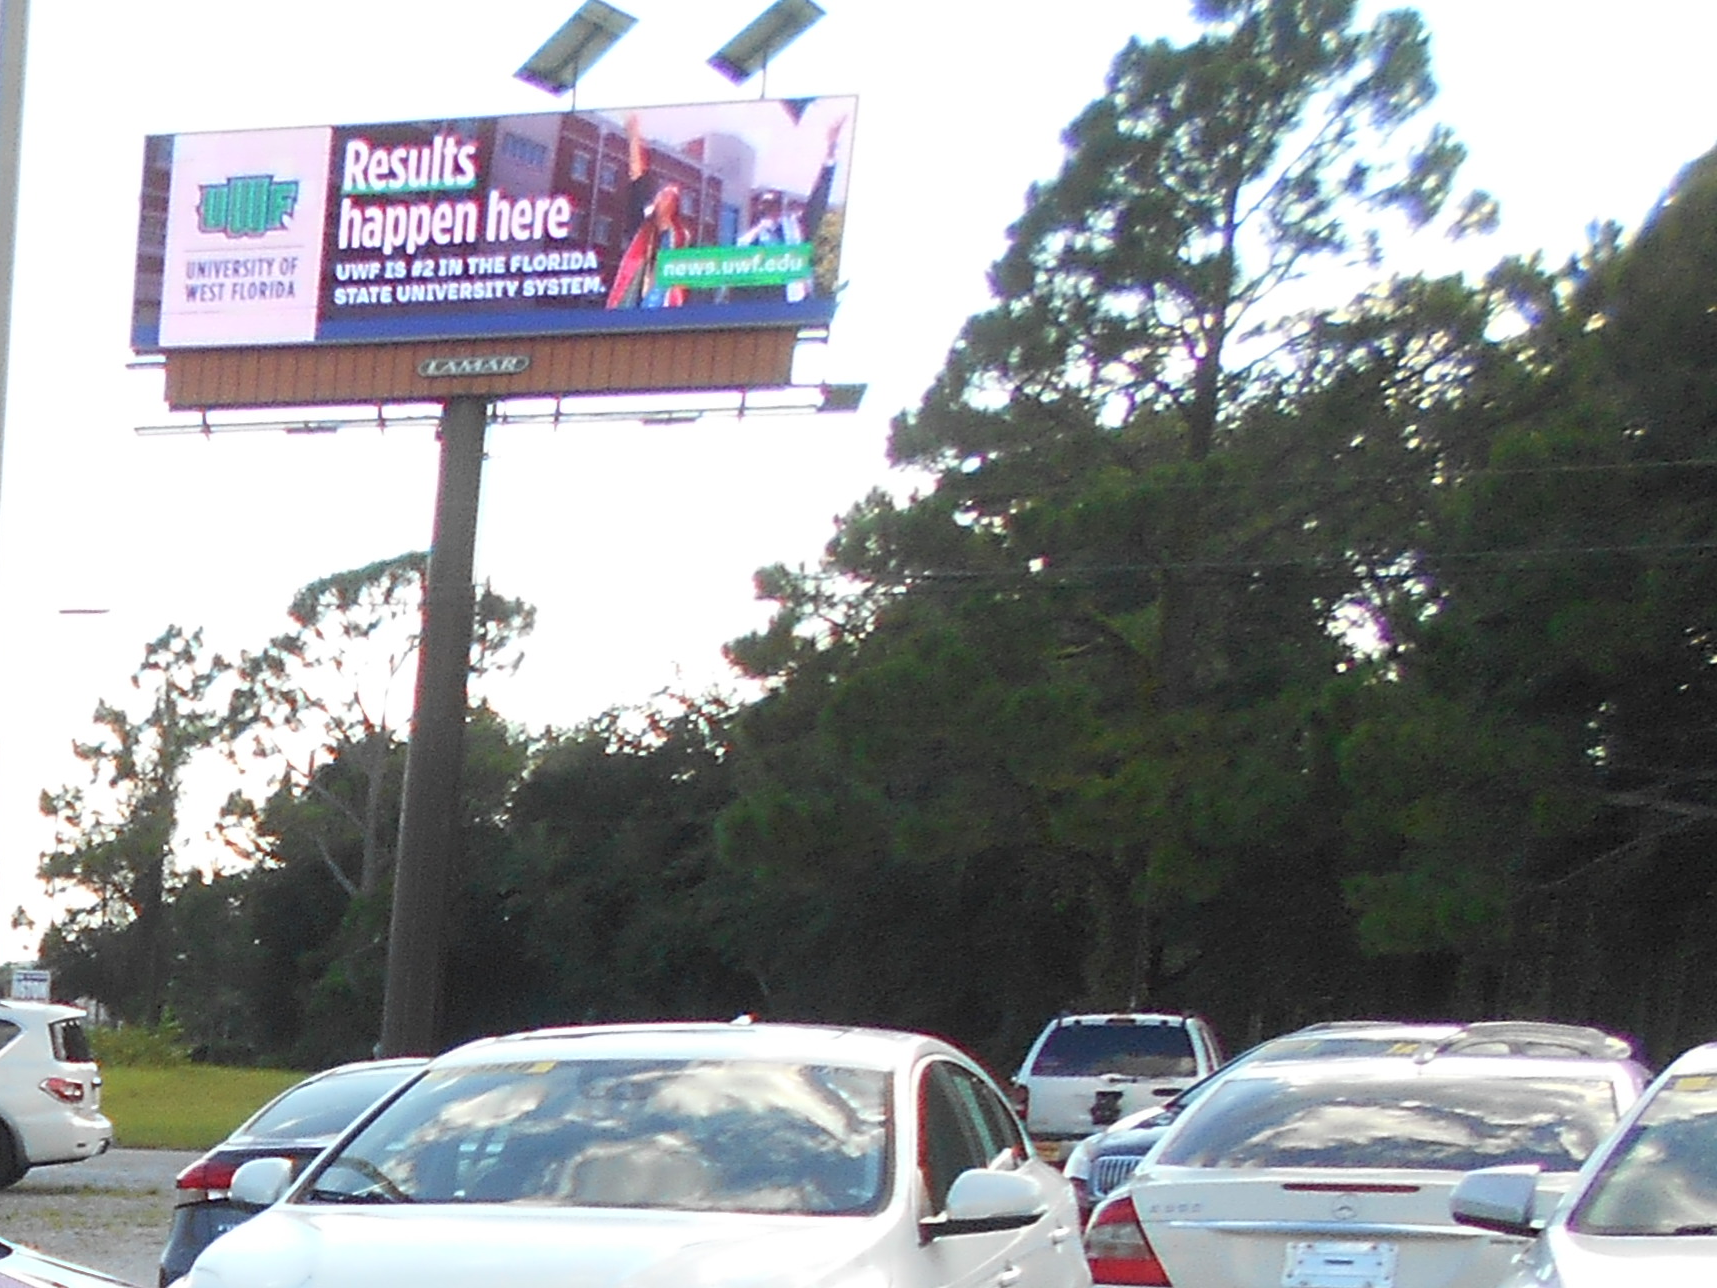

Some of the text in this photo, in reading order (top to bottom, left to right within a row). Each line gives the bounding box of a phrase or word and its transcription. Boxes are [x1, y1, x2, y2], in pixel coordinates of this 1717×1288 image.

[342, 134, 477, 191] Results
[338, 189, 572, 256] happen here
[185, 256, 299, 280] UNIVERSITY OF
[335, 250, 598, 281] UWF IS #2 IN THE FLORIDA
[662, 252, 803, 277] news.uwf.edu
[185, 280, 296, 303] WEST FLORIDA
[333, 275, 606, 306] STATE UNIVERSITY SYSTEM.
[426, 357, 518, 375] LAMAR
